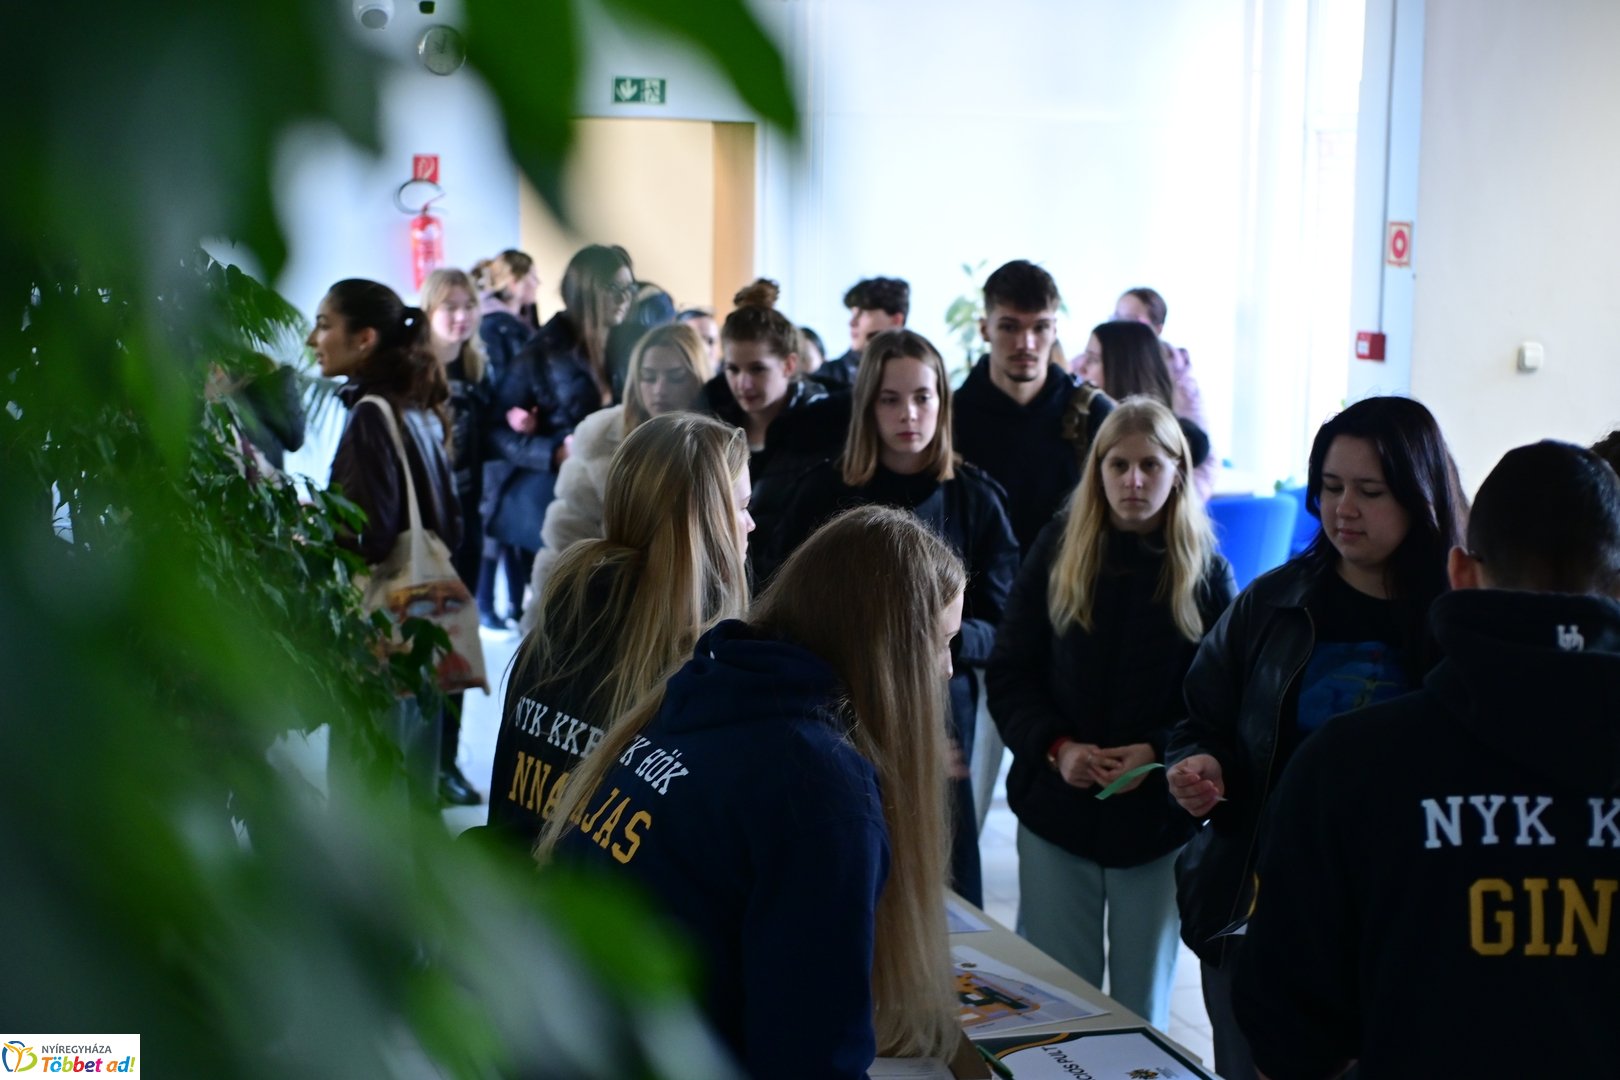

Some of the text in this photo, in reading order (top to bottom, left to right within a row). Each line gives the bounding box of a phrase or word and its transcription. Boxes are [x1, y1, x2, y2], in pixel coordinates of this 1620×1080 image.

[515, 696, 549, 737] NYK
[634, 748, 690, 796] HÖK
[1421, 794, 1556, 848] NYK
[1469, 877, 1618, 956] GIN
